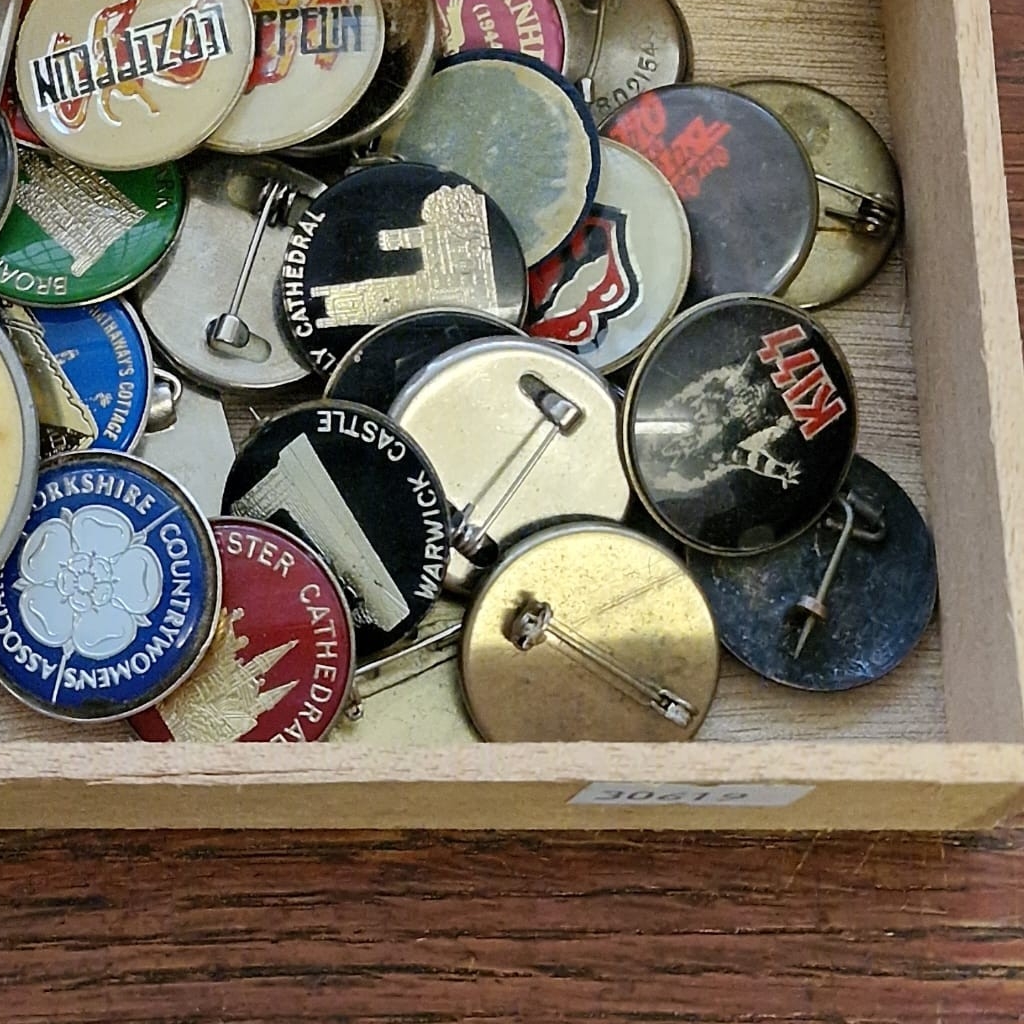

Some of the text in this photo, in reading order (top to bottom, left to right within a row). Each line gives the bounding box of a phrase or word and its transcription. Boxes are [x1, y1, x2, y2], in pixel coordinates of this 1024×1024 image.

[30, 18, 177, 107] ZEPPELIN
[254, 4, 363, 57] PPELIN
[284, 209, 337, 371] LY CATHEDRAL
[102, 382, 135, 442] COTTAGE
[756, 323, 848, 441] KISS
[316, 410, 447, 601] WARWICK CASTLE
[594, 787, 750, 804] 30619
